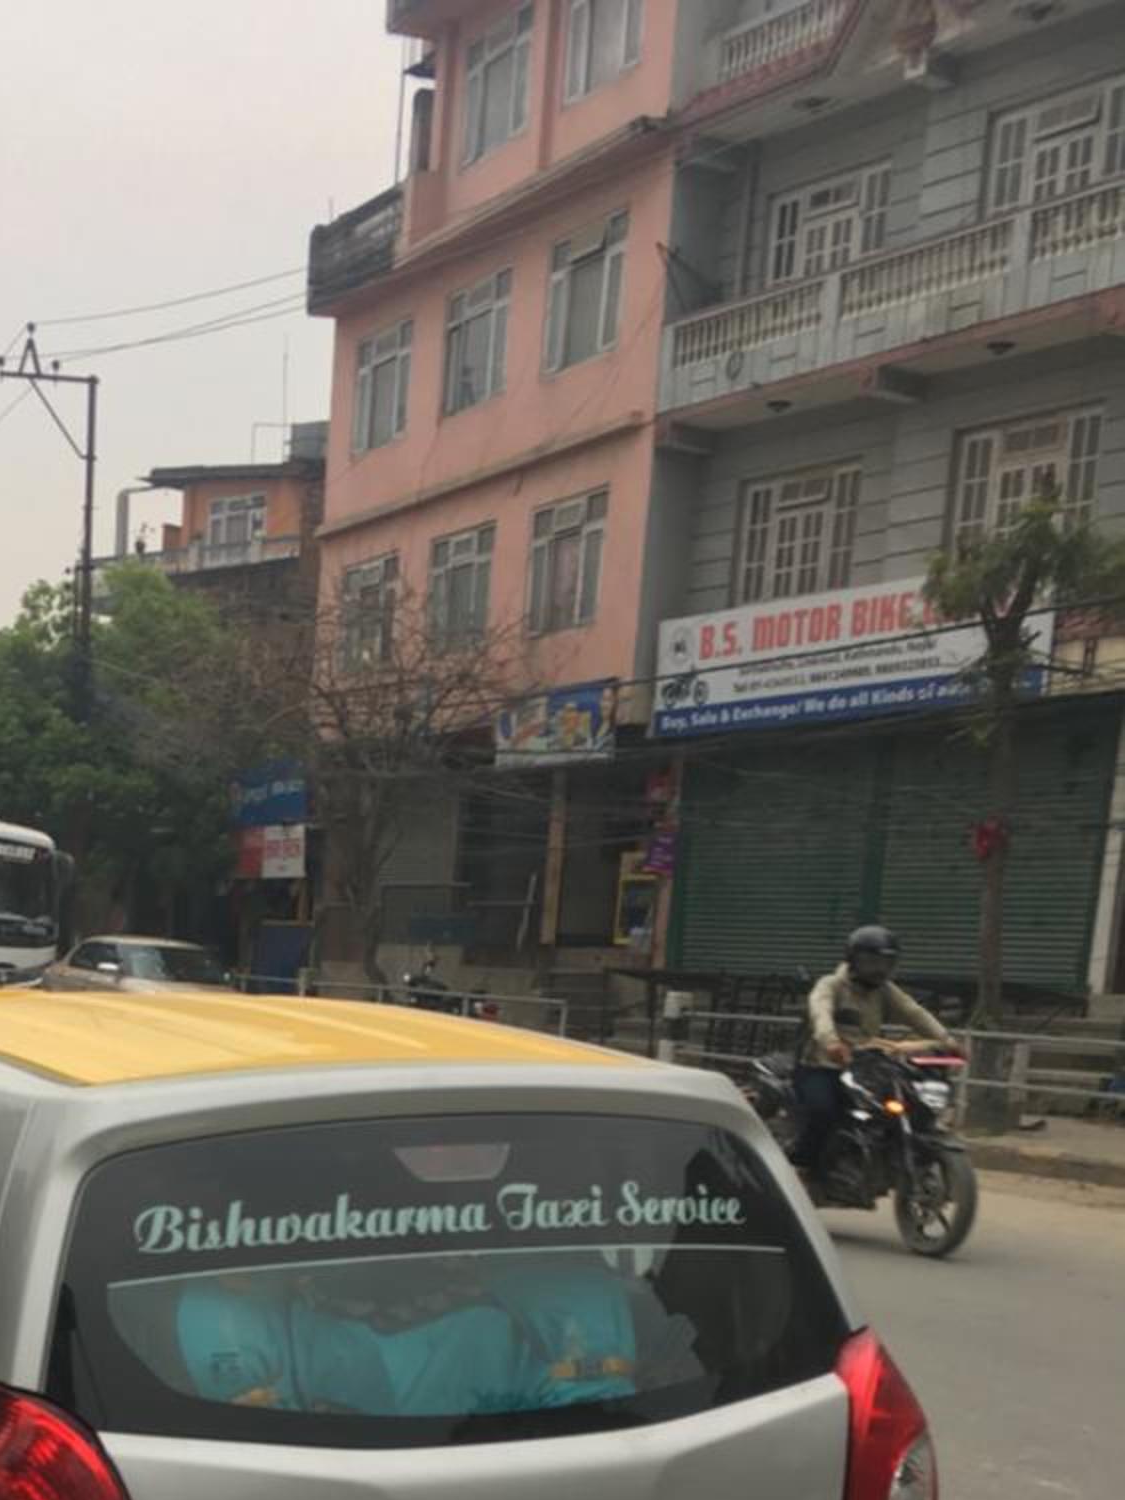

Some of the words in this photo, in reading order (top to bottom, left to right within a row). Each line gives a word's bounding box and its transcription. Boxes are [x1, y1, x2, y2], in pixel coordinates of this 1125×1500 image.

[698, 621, 742, 661] B.S.
[752, 604, 842, 652] MOTOR
[850, 591, 915, 639] BIKE
[827, 695, 847, 710] do
[134, 1194, 492, 1254] Bishwakarma
[498, 1183, 611, 1232] Taxi
[616, 1181, 746, 1227] Service
